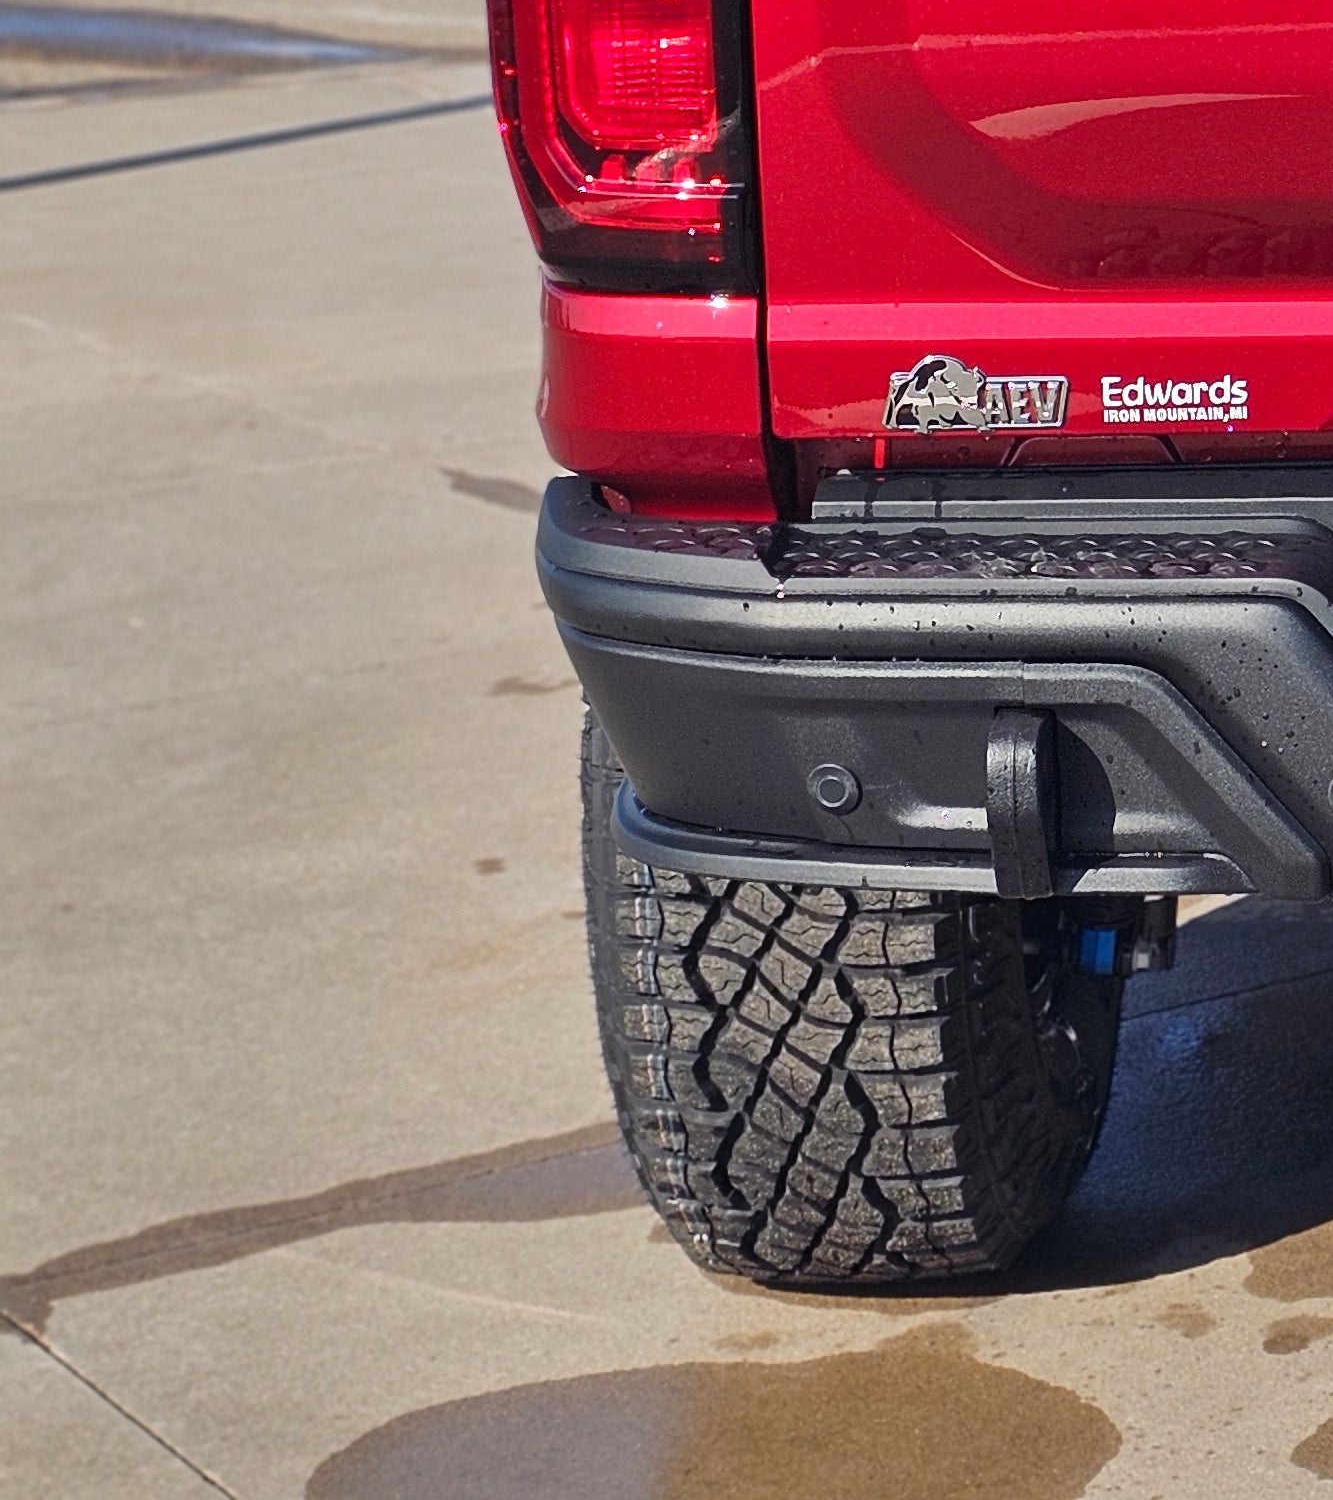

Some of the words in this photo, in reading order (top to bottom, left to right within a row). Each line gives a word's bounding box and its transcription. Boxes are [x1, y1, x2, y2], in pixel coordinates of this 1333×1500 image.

[985, 381, 1060, 425] AEV
[1100, 374, 1249, 407] Edwards
[1103, 408, 1141, 423] IRON
